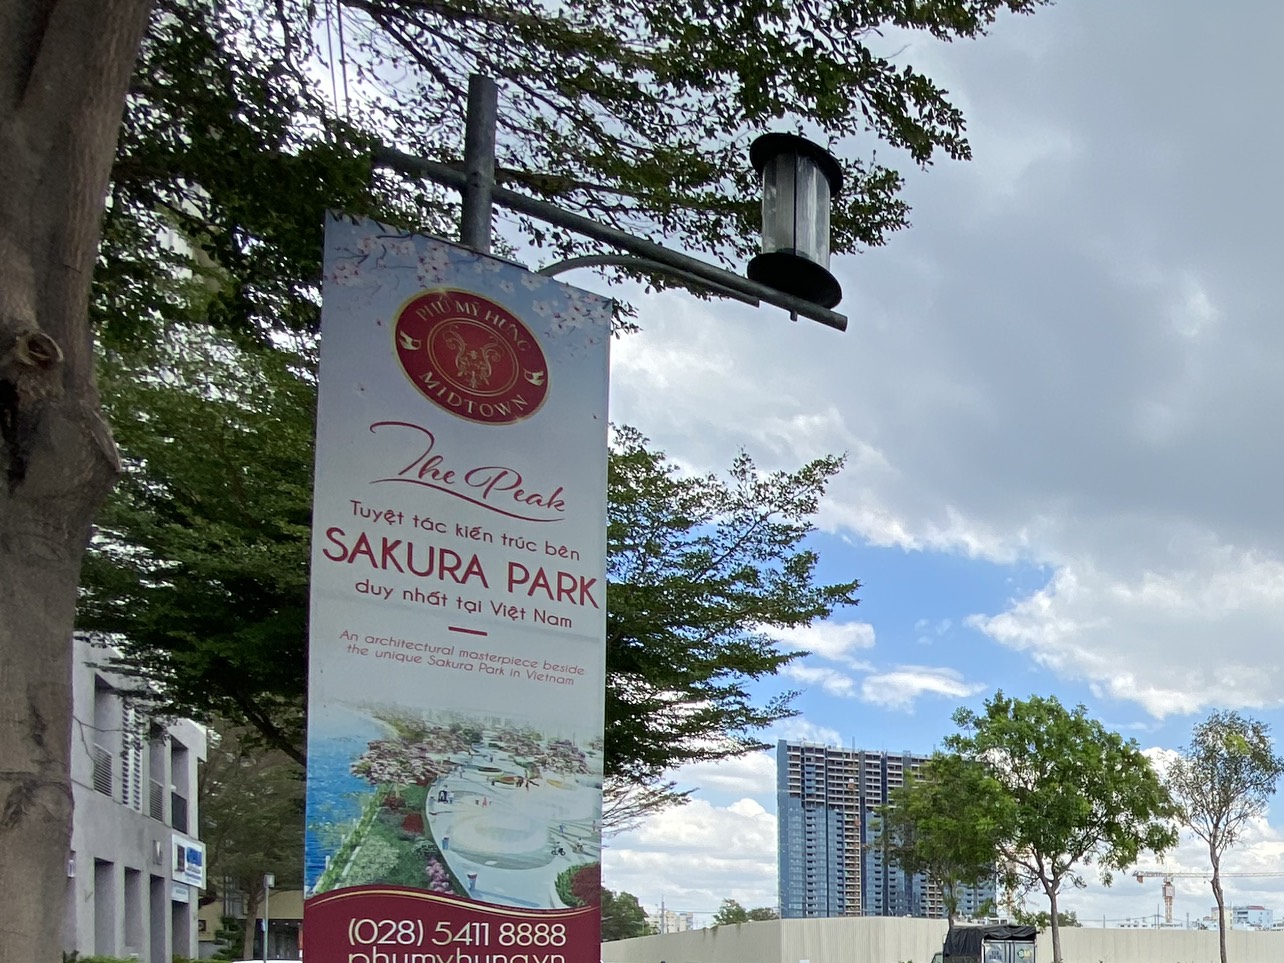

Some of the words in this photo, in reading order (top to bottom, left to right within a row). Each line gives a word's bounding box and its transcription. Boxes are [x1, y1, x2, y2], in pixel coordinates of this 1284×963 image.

[420, 371, 529, 418] MIDTOWN
[370, 421, 456, 486] The
[464, 466, 566, 512] Peak
[350, 500, 405, 526] Tuyệt
[412, 510, 447, 534] tác
[455, 523, 493, 544] kiến
[501, 532, 538, 552] trúc
[545, 541, 580, 561] bên
[322, 527, 490, 589] SAKURA
[507, 561, 600, 609] PARK
[355, 578, 394, 600] duy
[403, 587, 448, 607] nhất
[456, 596, 482, 614] tại
[490, 600, 526, 621] Việt
[534, 608, 572, 628] Nam
[339, 629, 359, 642] An
[365, 636, 455, 656] architectural
[459, 649, 539, 669] masterpiece
[543, 660, 585, 676] beside
[347, 643, 369, 656] the
[375, 650, 422, 665] unique
[427, 654, 474, 672] Sakura
[478, 662, 505, 676] Park
[509, 668, 521, 678] in
[526, 669, 575, 686] Vietnam
[348, 918, 424, 947] (028)
[431, 921, 490, 946] 5411
[498, 922, 567, 947] 8888
